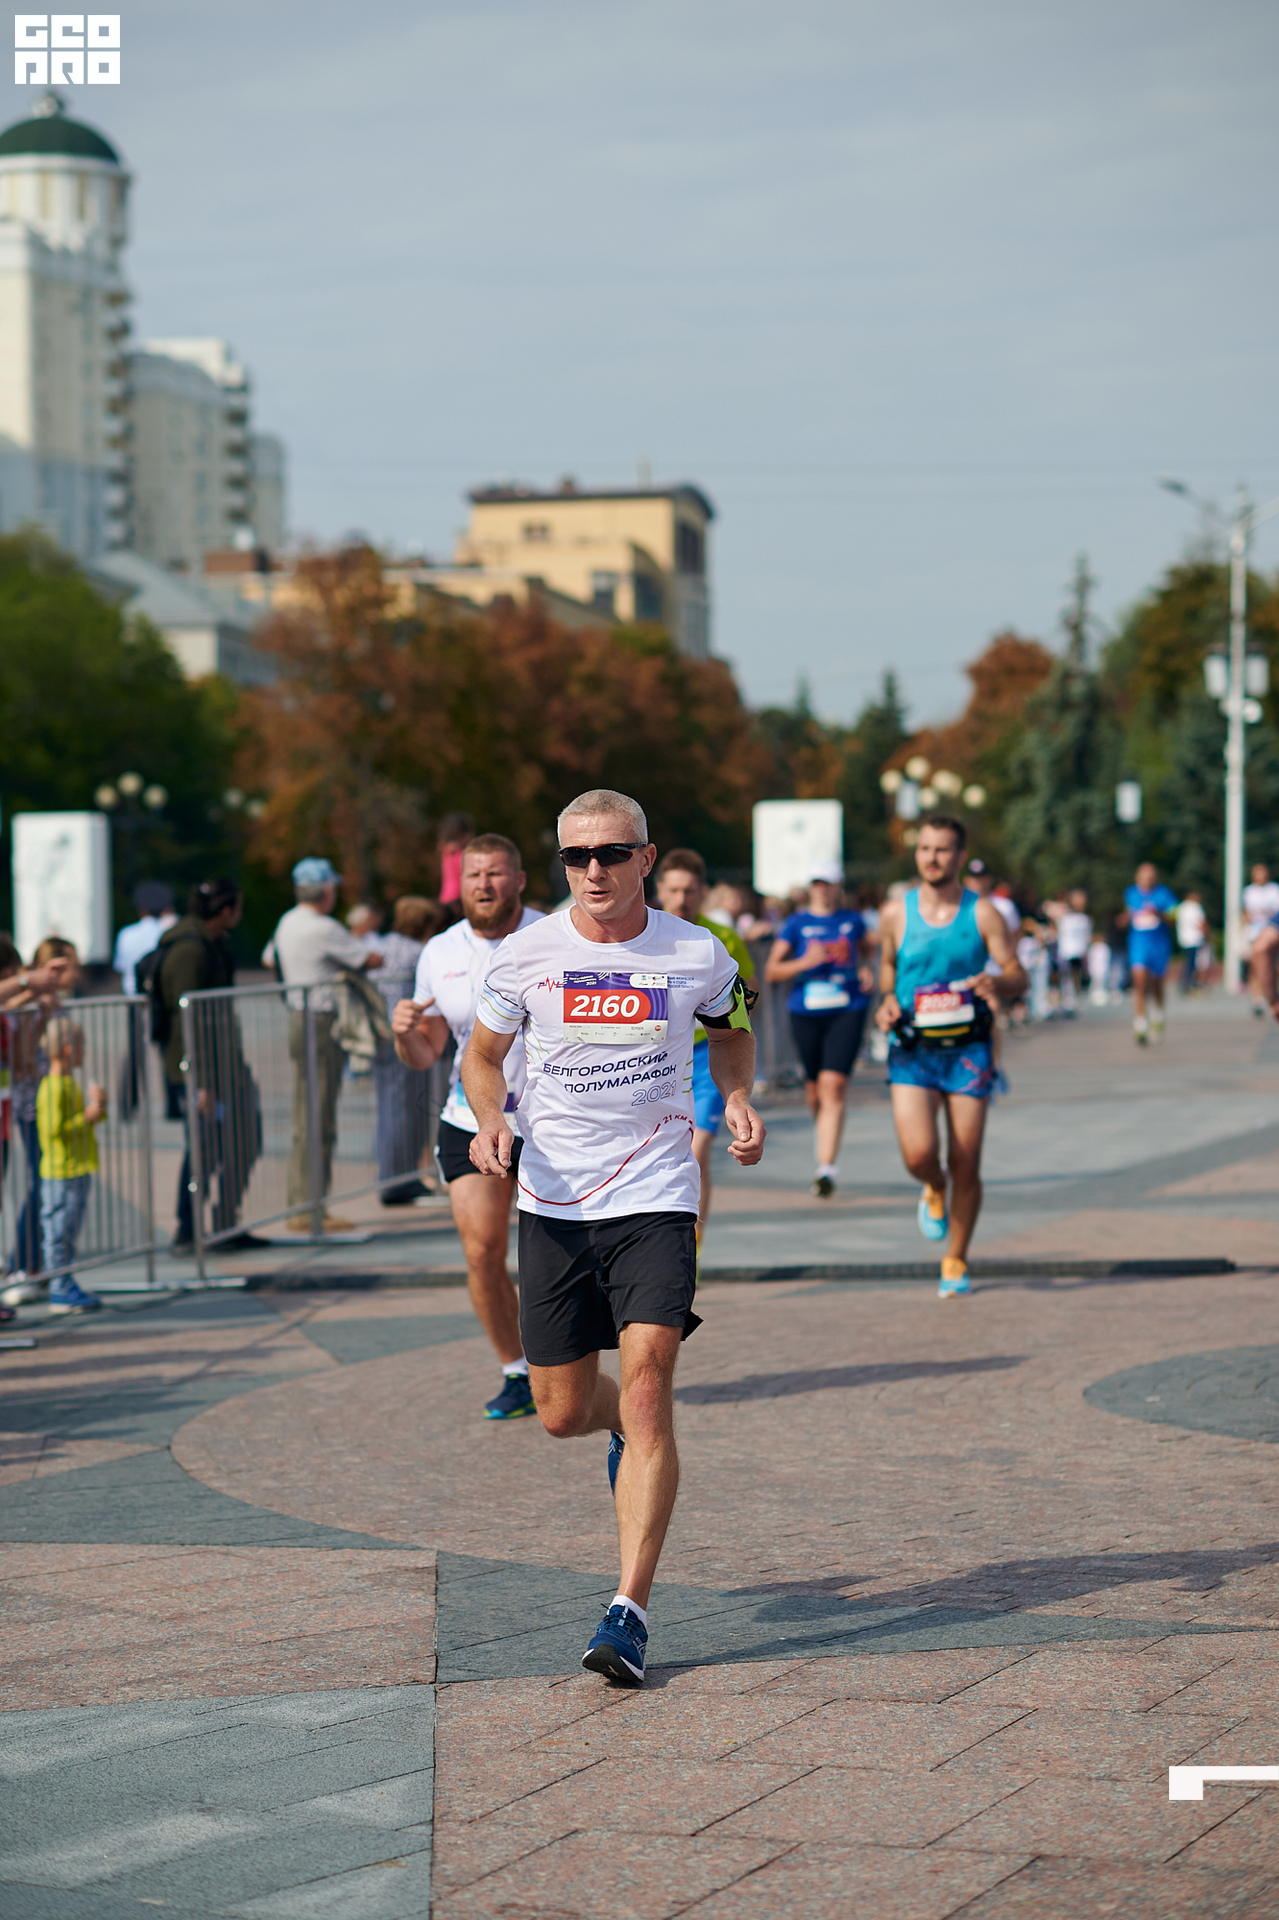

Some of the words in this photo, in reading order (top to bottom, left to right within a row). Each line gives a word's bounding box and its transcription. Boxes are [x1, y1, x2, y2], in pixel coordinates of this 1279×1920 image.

[570, 995, 640, 1017] 2160
[543, 1051, 668, 1077] БЕЛГОРОДСКИЙ
[564, 1064, 677, 1093] ПОЛУМАРАФОН
[631, 1080, 677, 1106] 2021
[663, 1114, 672, 1124] 21
